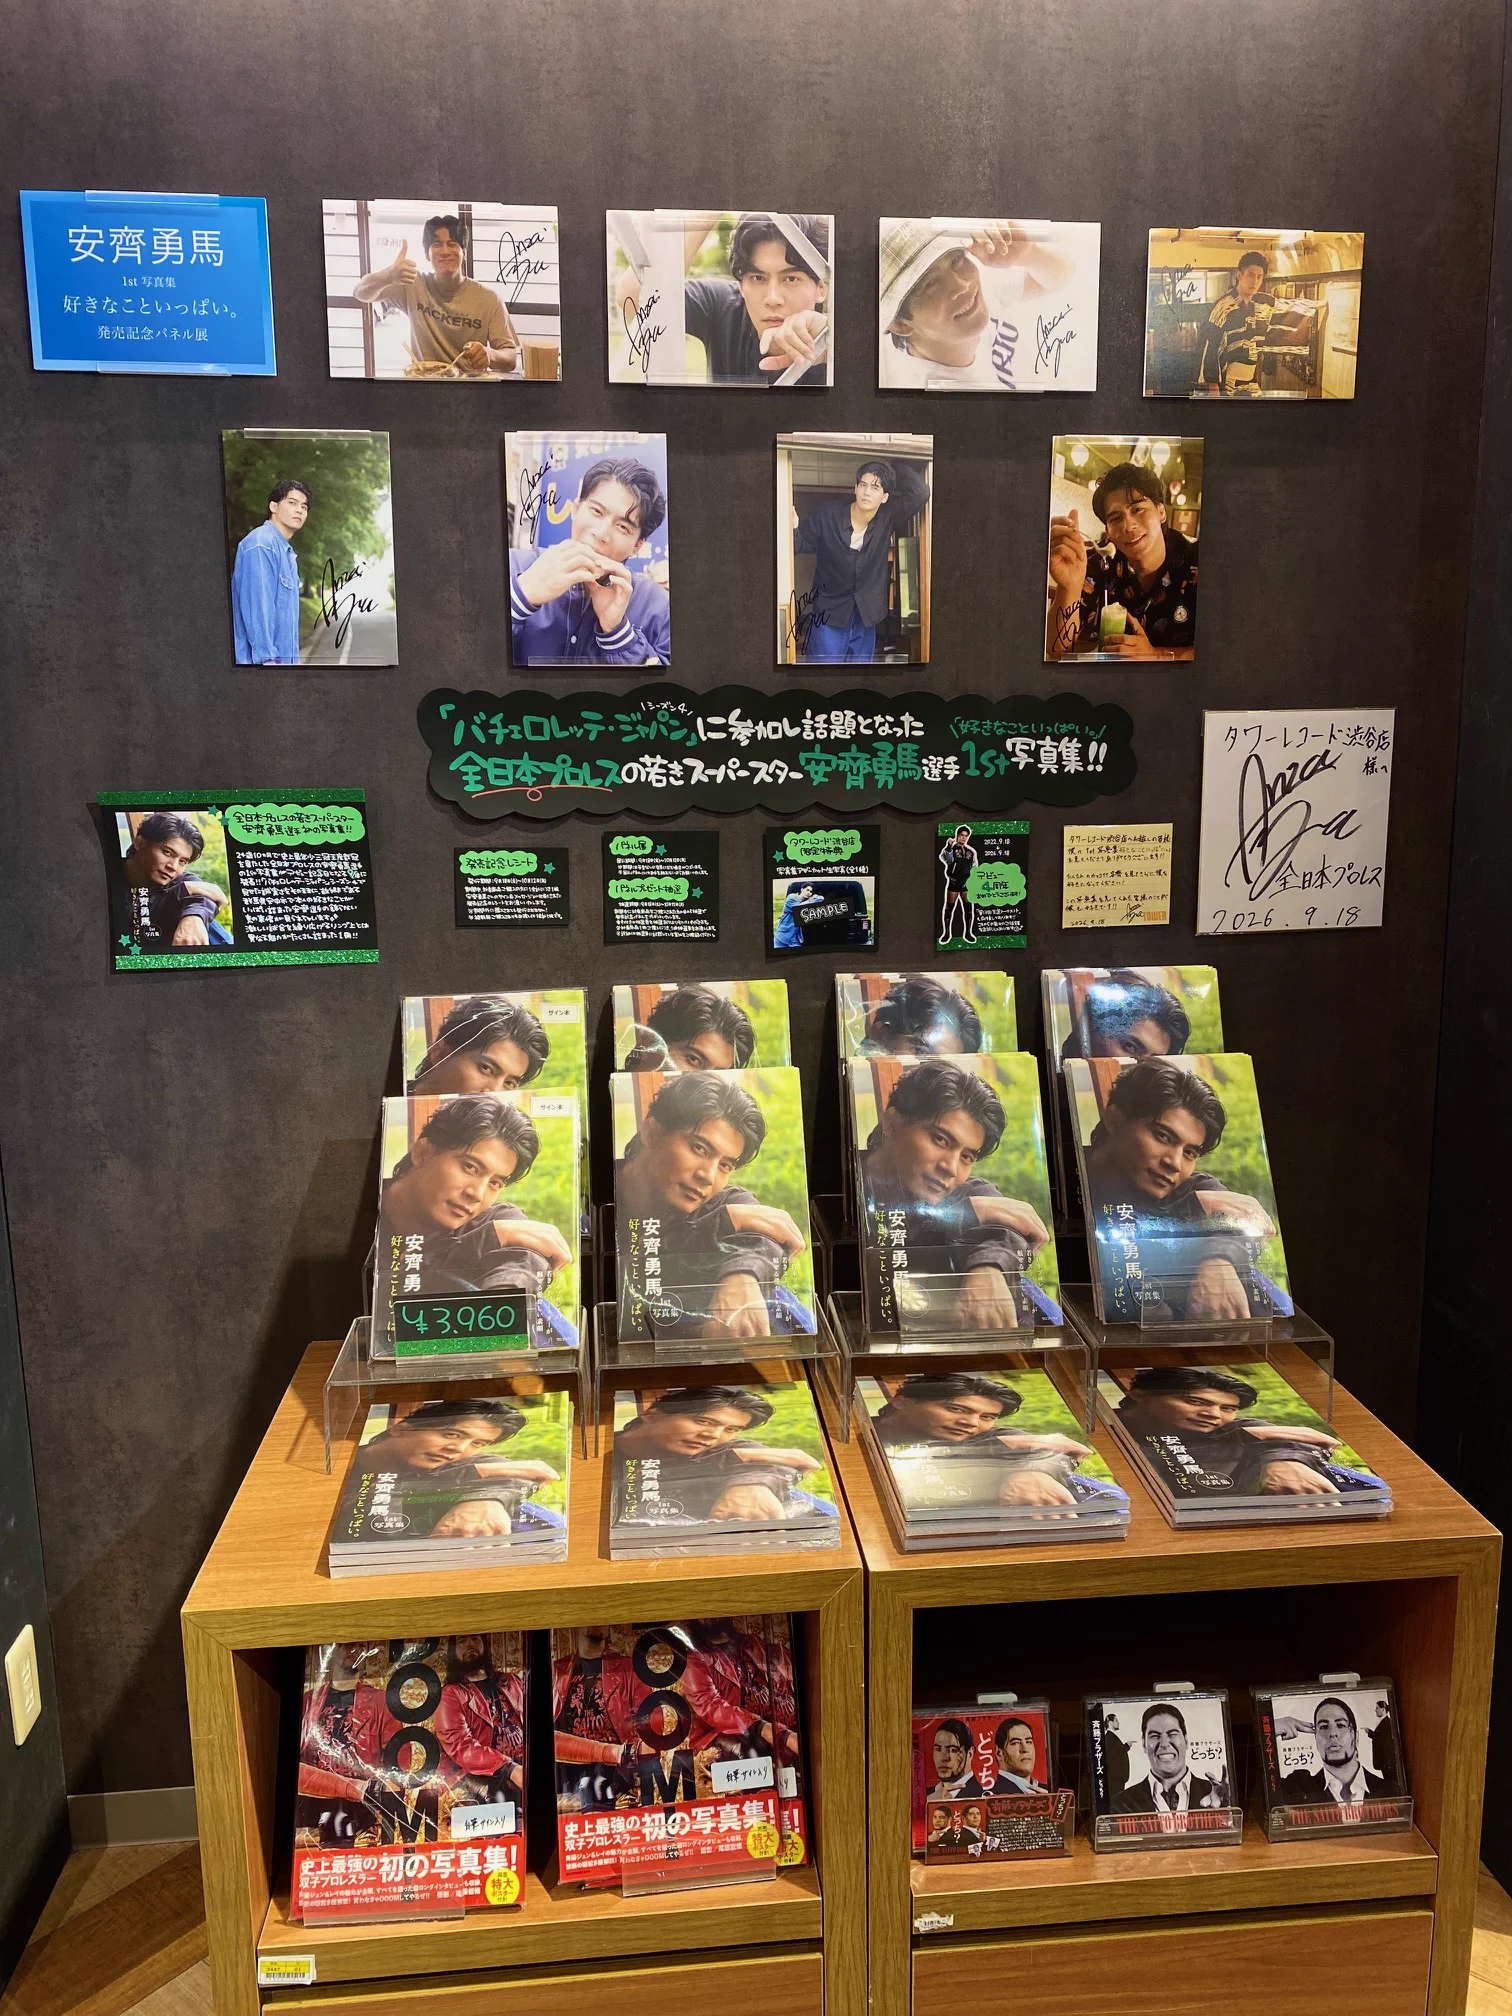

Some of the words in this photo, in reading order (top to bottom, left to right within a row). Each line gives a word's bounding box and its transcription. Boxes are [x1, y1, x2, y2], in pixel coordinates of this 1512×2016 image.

[67, 224, 224, 267] 安齊勇馬
[122, 276, 138, 288] 1st
[141, 276, 176, 288] 写真集
[62, 294, 237, 319] 好きなこといっぱい。
[416, 302, 483, 330] PACKERS
[97, 325, 209, 342] 発売記念パネル展
[1224, 723, 1391, 754] タワーレコード渋谷店
[1362, 756, 1388, 776] 様へ
[1268, 853, 1383, 899] 全日本プロレス
[800, 901, 849, 924] SAMPLE
[548, 1008, 571, 1018] サイン本
[540, 1102, 564, 1112] サイン本
[888, 1209, 911, 1289] 安齊勇馬
[1116, 1203, 1142, 1280] 安齊勇馬
[642, 1217, 664, 1297] 安齊勇馬
[1160, 1435, 1205, 1475] 安齊勇馬
[640, 1459, 661, 1503] 安齊勇馬
[367, 1472, 398, 1517] 安齊勇馬
[1189, 1746, 1223, 1761] どっち?
[1283, 1751, 1314, 1767] どっち?
[641, 1799, 775, 1842] 初の写真集!
[1117, 1816, 1139, 1834] THE
[1141, 1813, 1172, 1834] SAITO
[1288, 1808, 1313, 1825] THE
[1313, 1805, 1343, 1824] SAITO
[565, 1815, 640, 1839] 史上最強の
[751, 1832, 774, 1844] 特大
[953, 1810, 962, 1844] どっち?
[564, 1834, 641, 1852] 双子プロレスラー
[300, 1855, 377, 1876] 史上最強の
[378, 1844, 518, 1884] 初の写真集!
[299, 1873, 377, 1889] 双子プロレスラー
[491, 1878, 514, 1890] 特大
